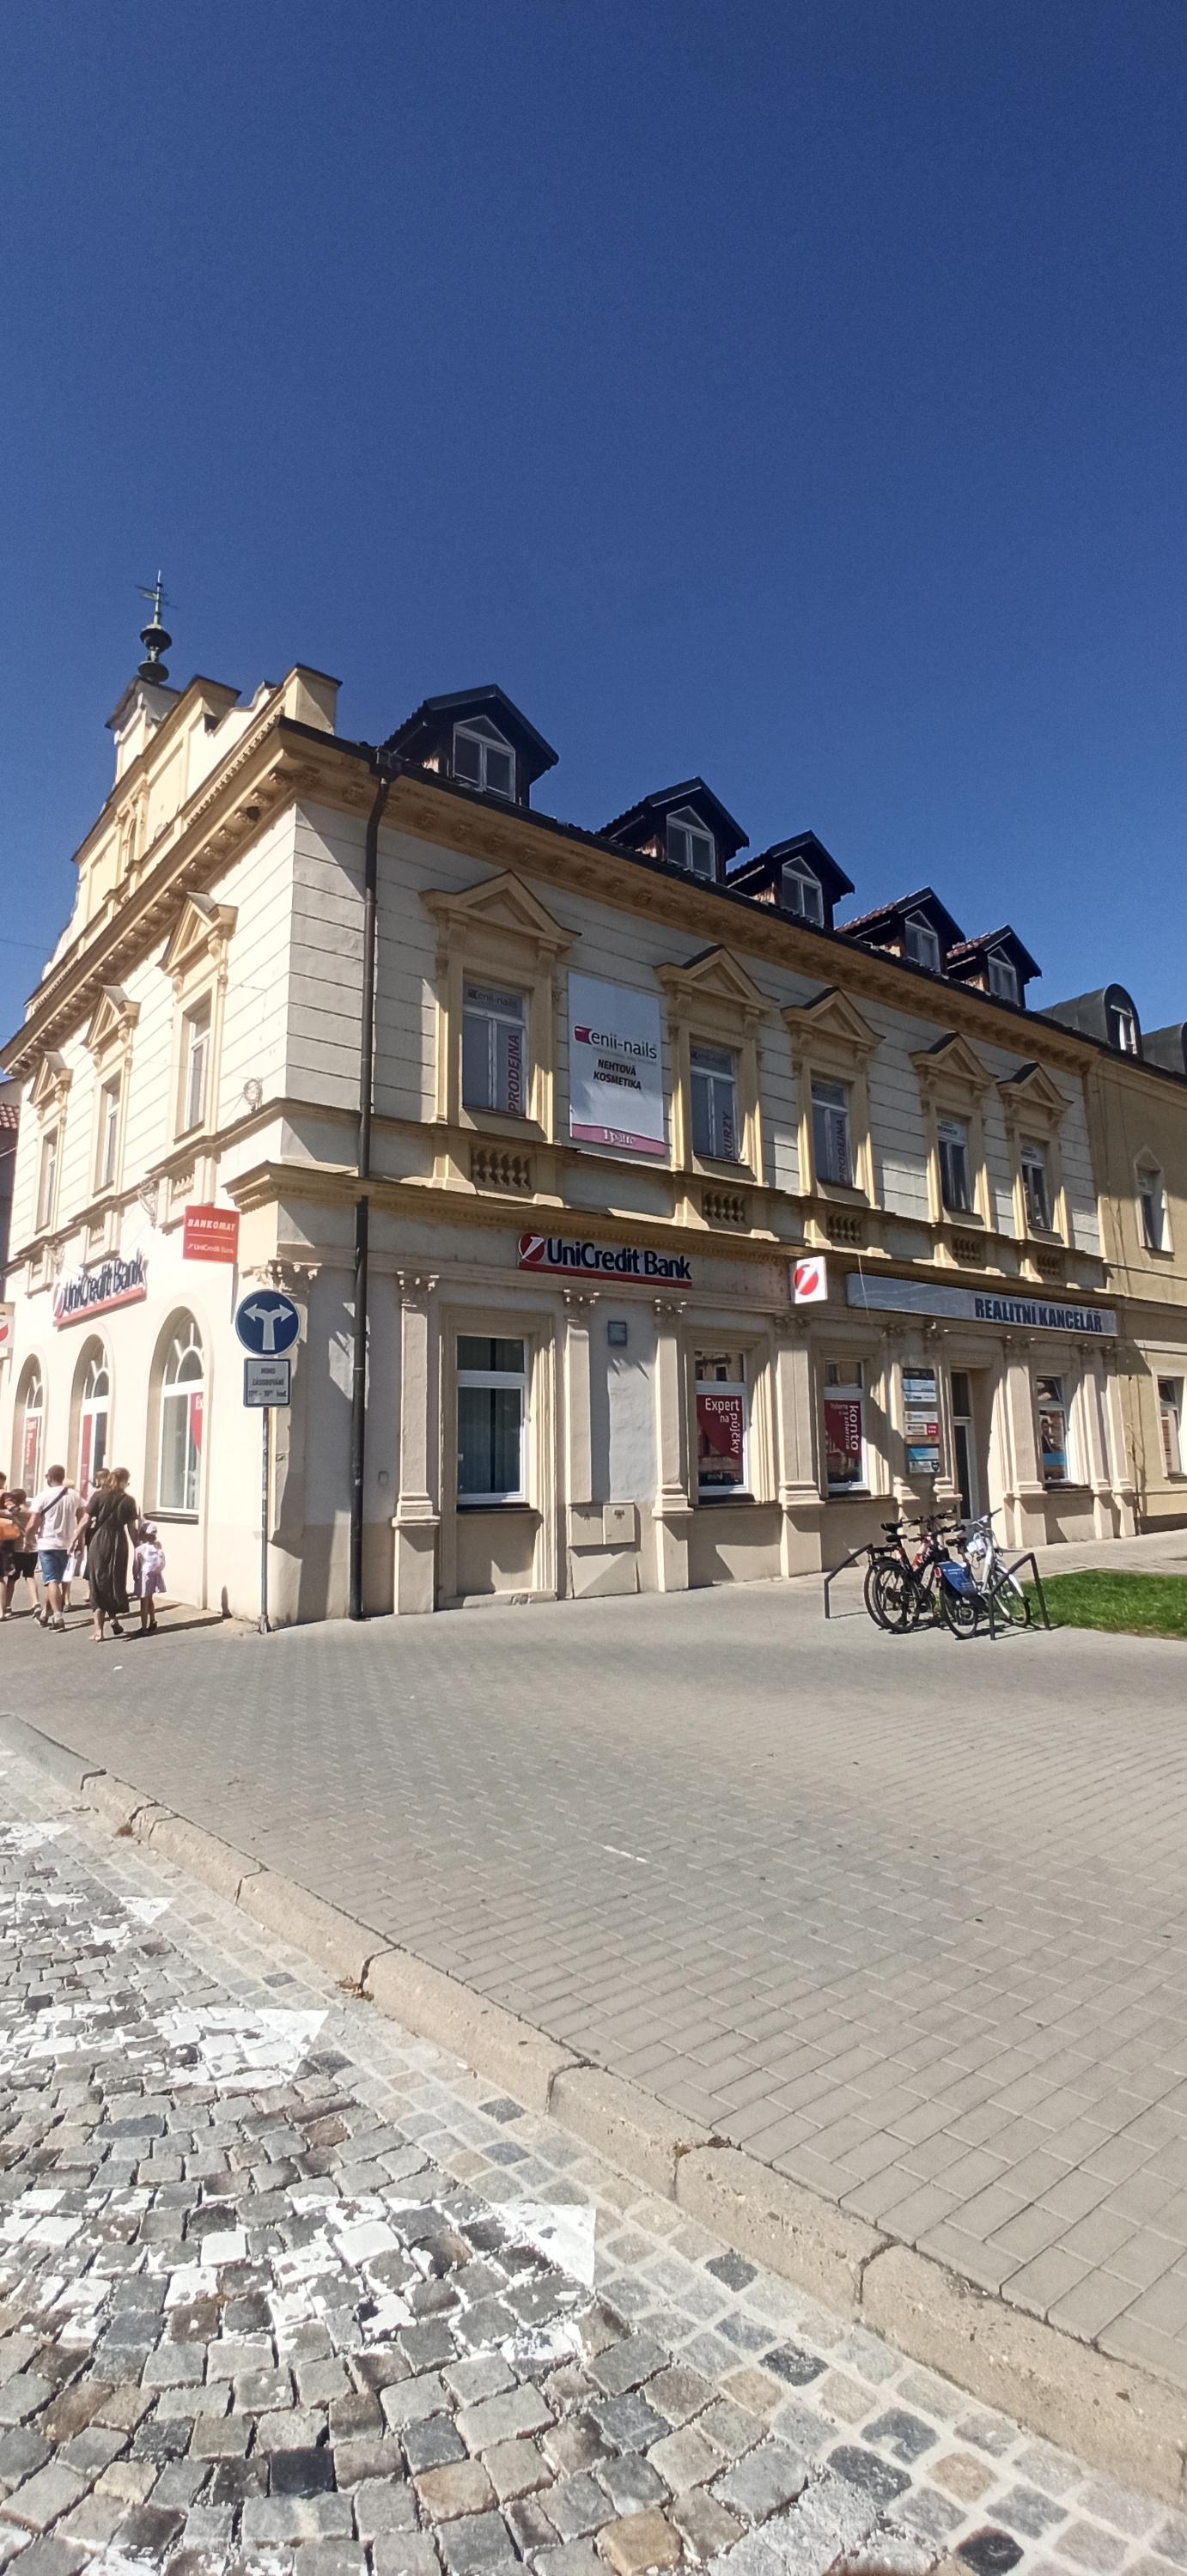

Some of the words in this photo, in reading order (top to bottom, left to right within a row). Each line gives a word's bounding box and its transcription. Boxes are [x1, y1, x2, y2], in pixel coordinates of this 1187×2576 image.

[591, 1031, 658, 1060] enii-nails
[508, 1035, 521, 1114] PRODEJNA
[594, 1071, 642, 1091] KOSMETIKA
[598, 1059, 636, 1076] NEHTOVÁ
[722, 1111, 733, 1157] KURZY
[837, 1120, 847, 1183] PRODEJNA
[187, 1218, 235, 1231] BANKOMAT
[547, 1237, 640, 1273] UniCredit
[644, 1250, 691, 1279] Bank
[63, 1262, 112, 1312] UniCredit
[113, 1249, 143, 1293] Bank
[975, 1297, 1037, 1325] REALITNÍ
[1038, 1306, 1103, 1332] KANCELÁŘ
[705, 1398, 740, 1413] Expert
[729, 1413, 740, 1454] půjčky
[849, 1405, 859, 1451] konto
